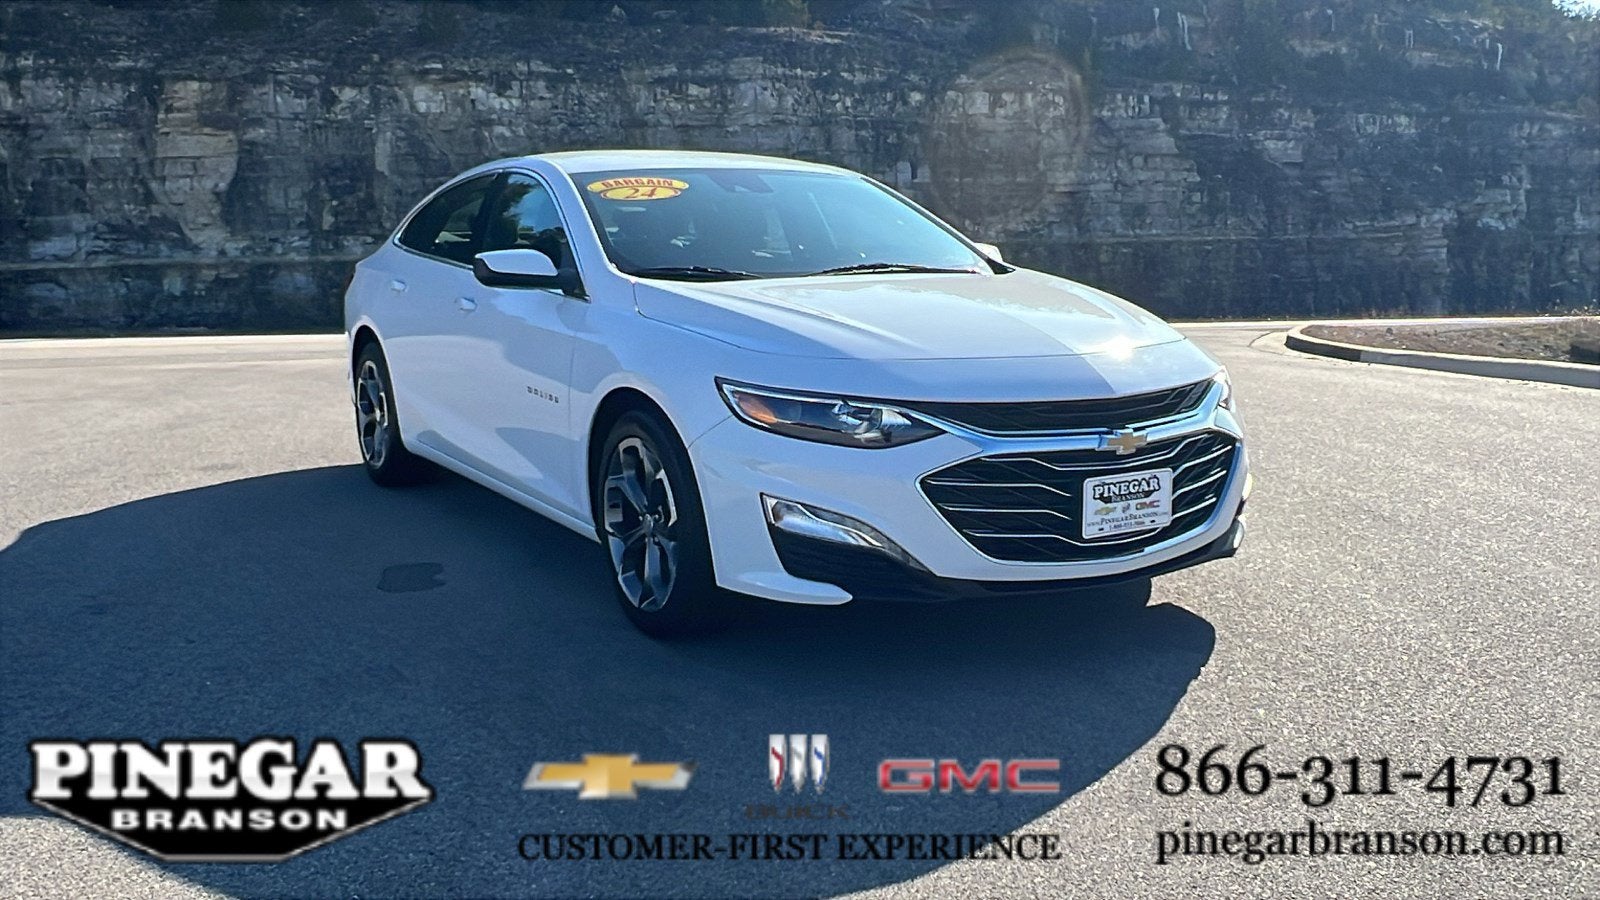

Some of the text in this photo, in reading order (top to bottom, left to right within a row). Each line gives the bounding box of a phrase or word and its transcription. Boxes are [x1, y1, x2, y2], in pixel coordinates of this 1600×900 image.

[601, 178, 673, 188] BARGAIN
[624, 187, 657, 199] 24
[1094, 479, 1160, 498] PINEGAR
